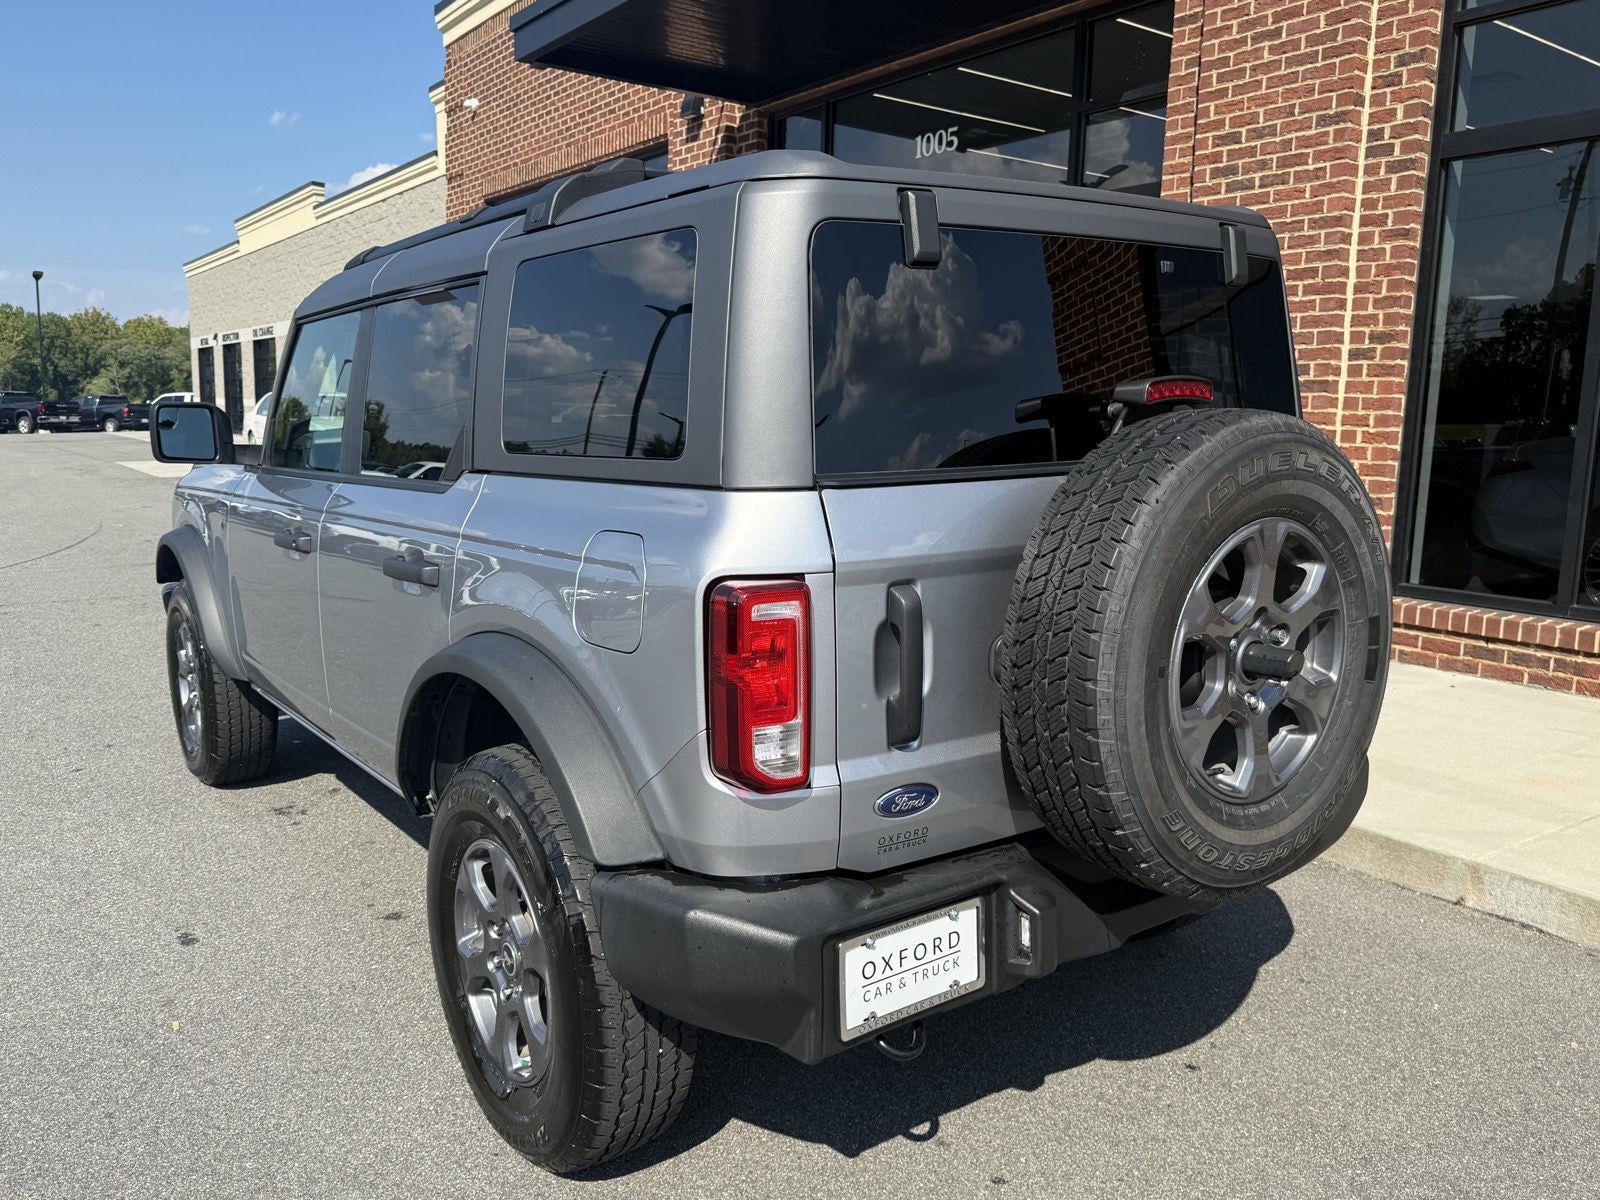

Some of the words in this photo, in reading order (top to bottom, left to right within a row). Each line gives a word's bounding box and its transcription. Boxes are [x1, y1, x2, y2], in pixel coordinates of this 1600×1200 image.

[914, 126, 959, 159] 1005
[1207, 450, 1362, 519] DUELER
[891, 792, 926, 813] Ford
[1159, 760, 1358, 872] BRIDGESTONE
[877, 846, 893, 856] CAR
[902, 837, 928, 850] TRUCK
[878, 826, 929, 846] OXFORD
[861, 930, 961, 981] OXFORD
[862, 981, 893, 1003] CAR
[898, 976, 907, 990] &
[912, 955, 961, 984] TRUCK
[858, 1011, 903, 1035] OXFORD
[905, 1002, 926, 1016] CAR
[938, 985, 970, 1004] TRUCK
